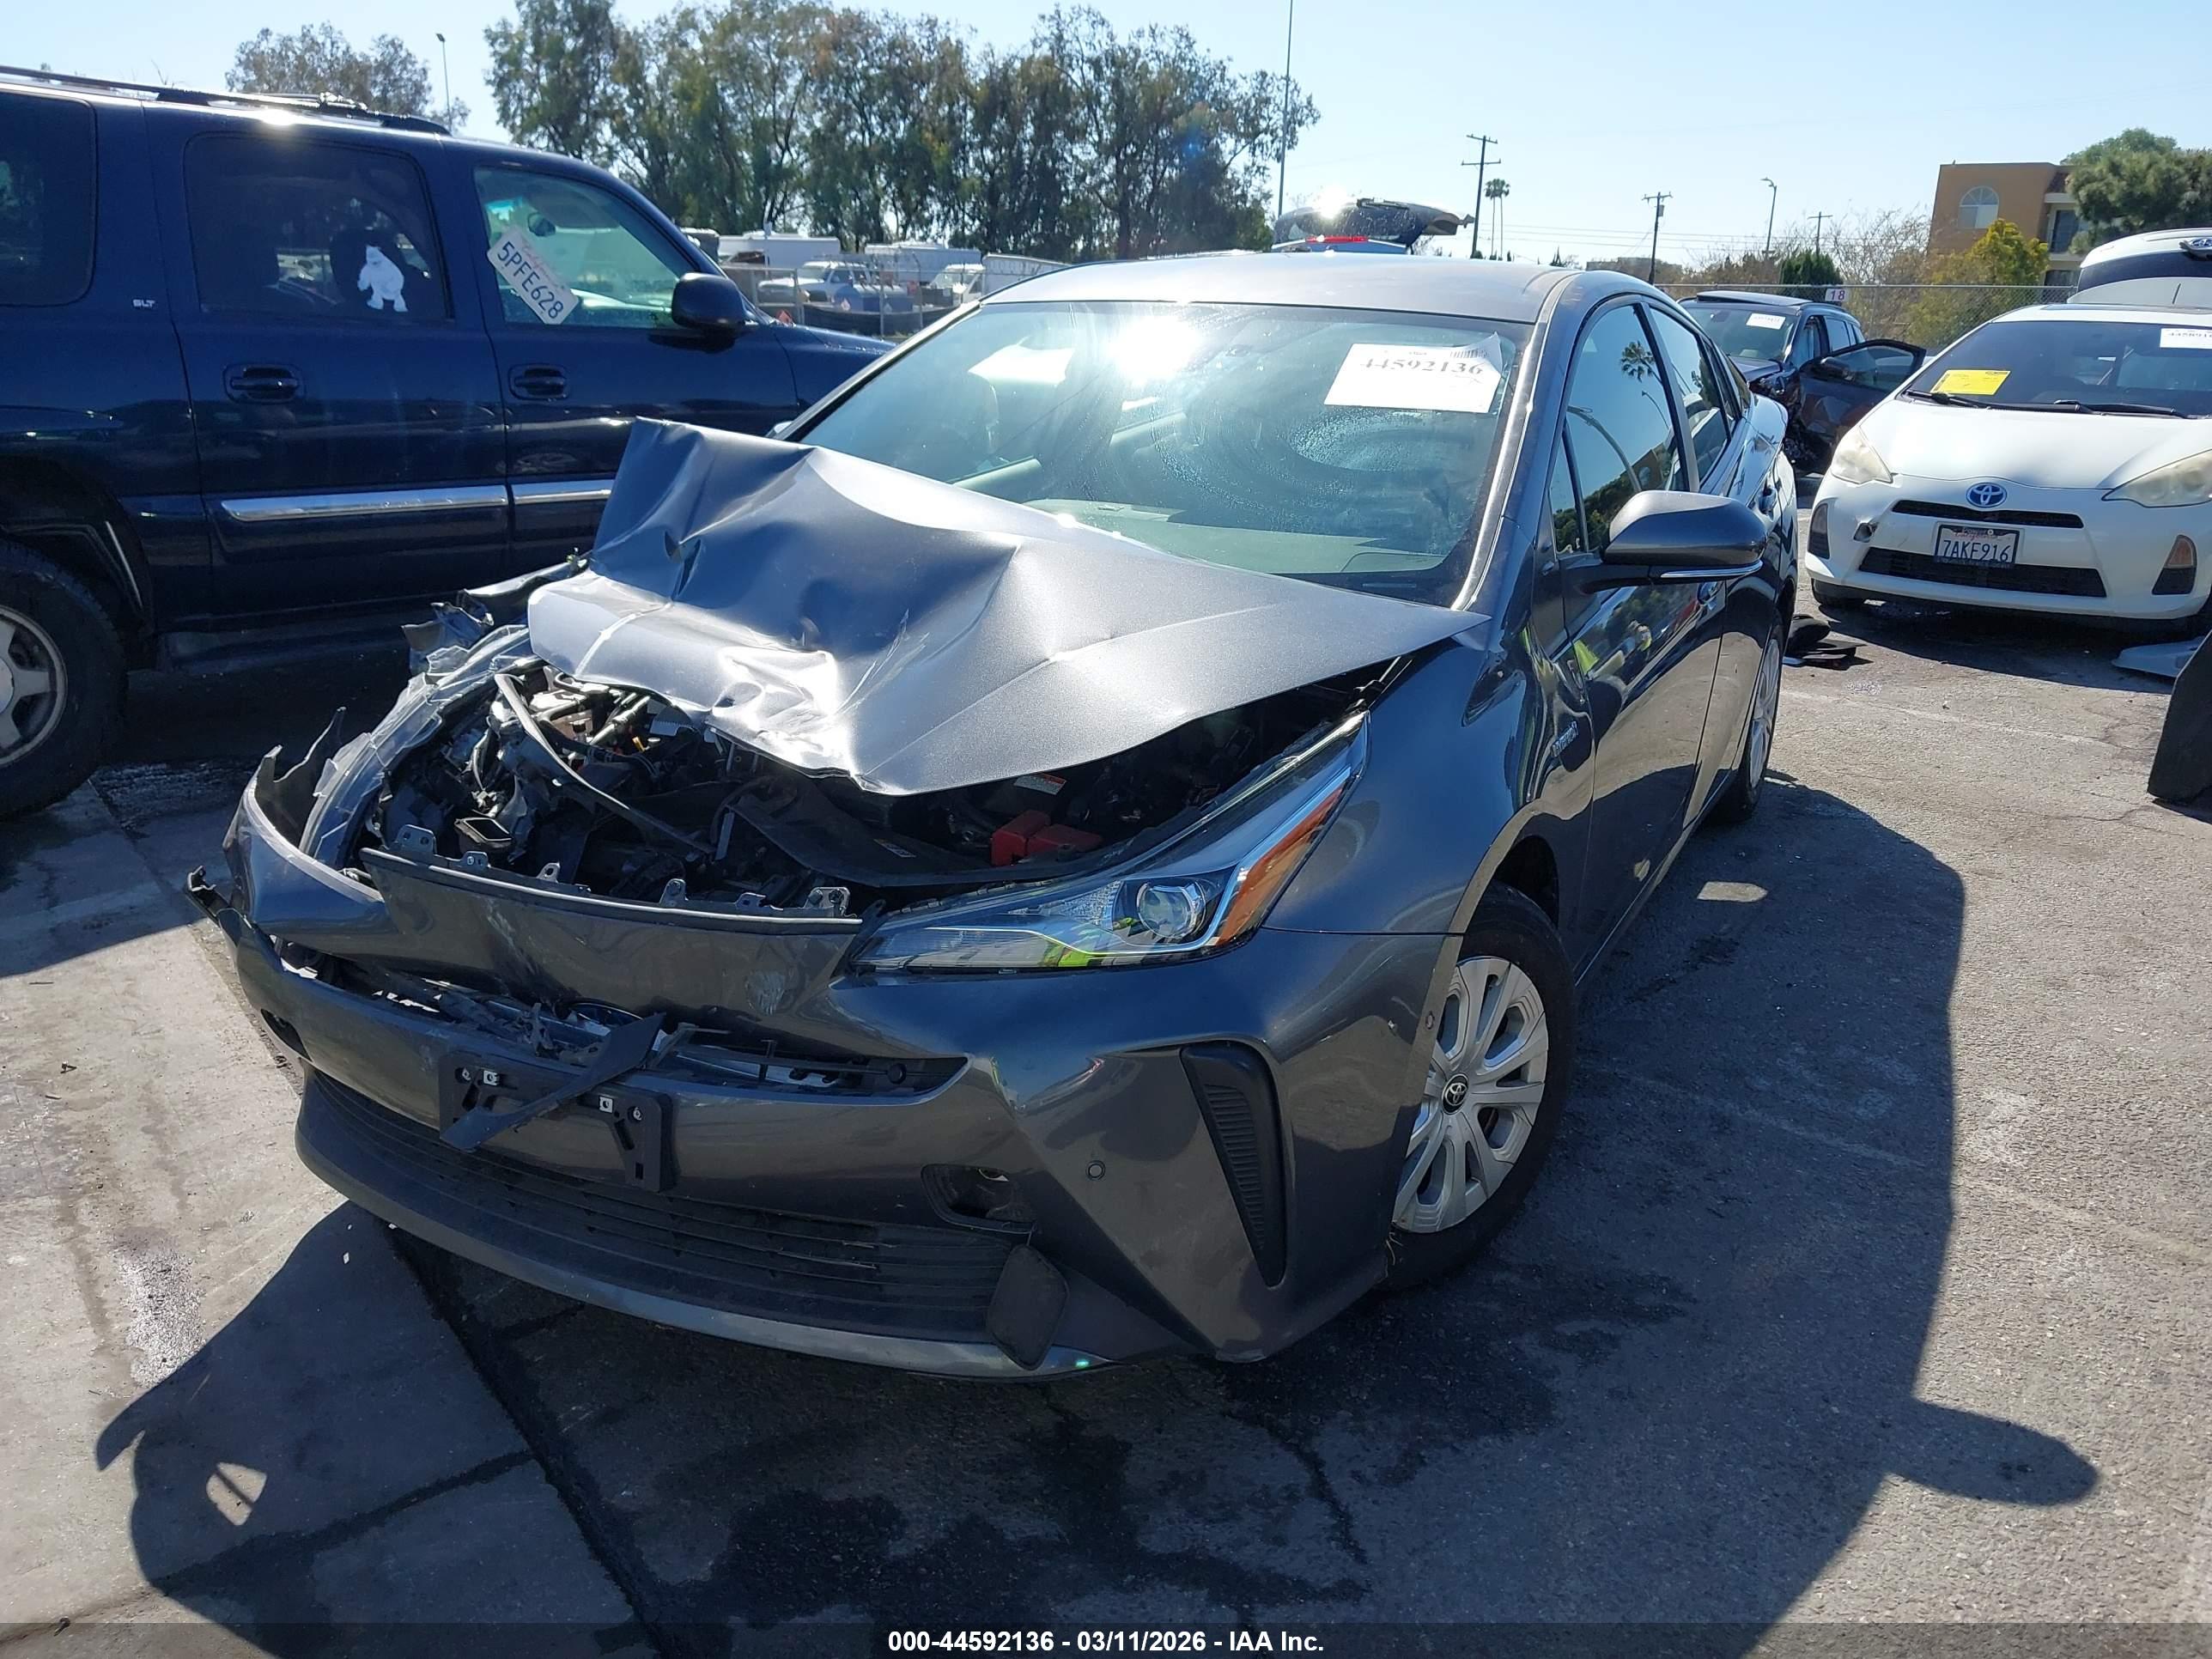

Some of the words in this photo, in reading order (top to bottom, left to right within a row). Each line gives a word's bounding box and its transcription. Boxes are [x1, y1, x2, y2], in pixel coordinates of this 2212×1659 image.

[497, 240, 564, 319] 5PFE628
[132, 299, 155, 307] SLT
[1830, 289, 1845, 301] 18
[1360, 358, 1485, 375] 44592136
[1943, 540, 2011, 562] 7AKF916
